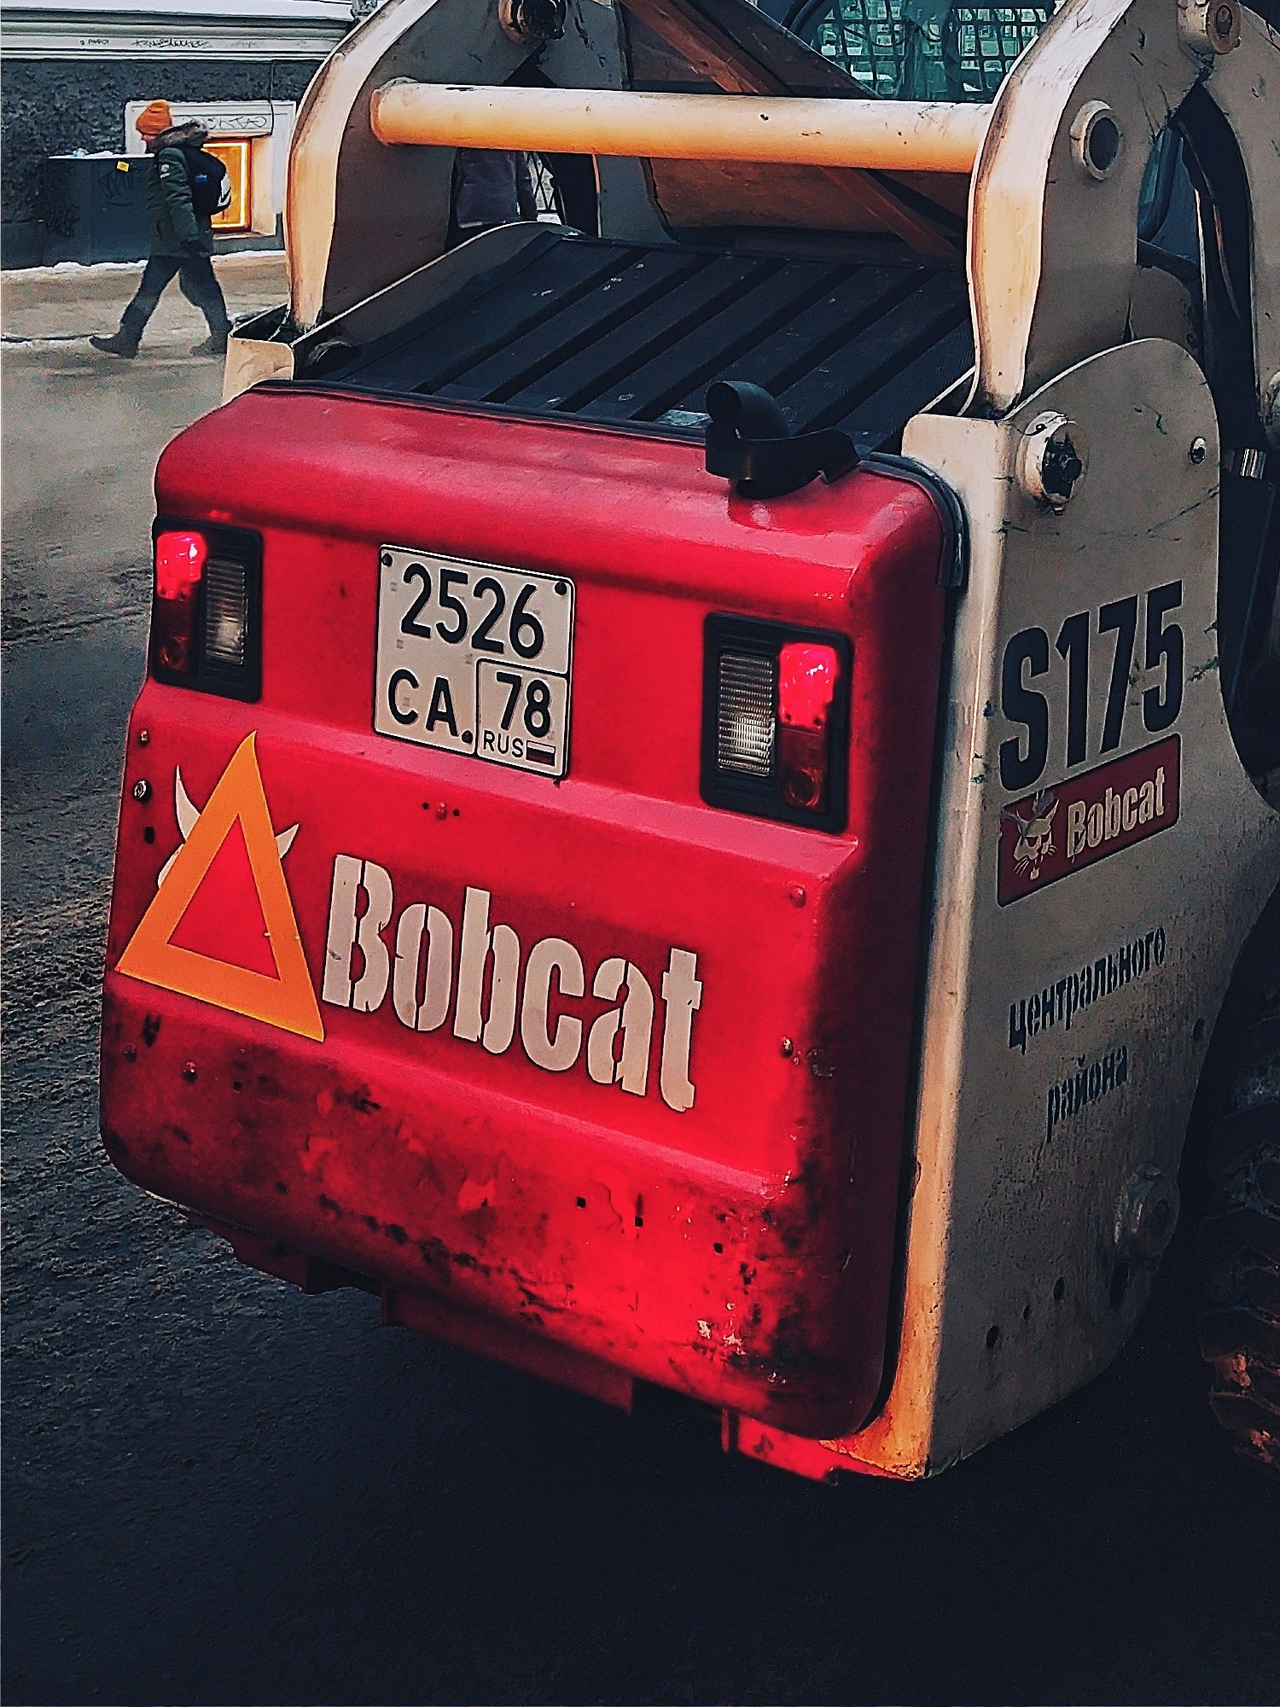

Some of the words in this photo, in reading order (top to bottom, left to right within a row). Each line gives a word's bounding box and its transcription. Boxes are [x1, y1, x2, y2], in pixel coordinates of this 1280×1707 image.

[401, 563, 545, 659] 2526
[388, 668, 459, 737] СА
[496, 671, 551, 738] 78
[999, 579, 1184, 792] S175
[483, 730, 524, 758] RUS
[1066, 766, 1165, 860] Bobcat
[322, 854, 702, 1112] Bobcat
[1008, 926, 1166, 1056] центрального
[1046, 1045, 1128, 1144] района
